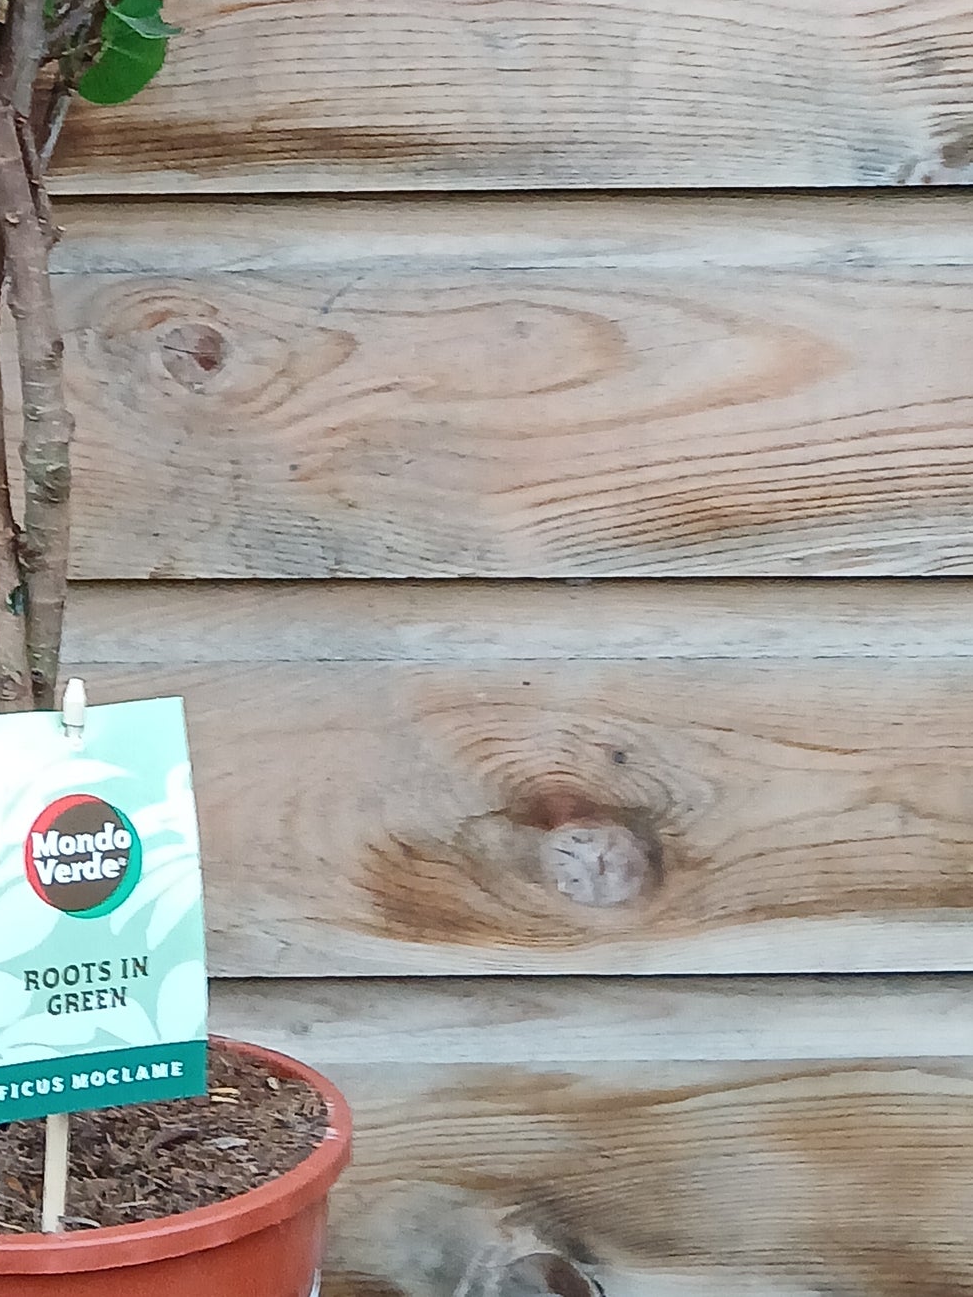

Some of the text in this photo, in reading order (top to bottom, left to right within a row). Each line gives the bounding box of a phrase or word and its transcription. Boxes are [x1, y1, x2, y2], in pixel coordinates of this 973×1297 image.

[31, 821, 132, 859] Mondo
[24, 956, 149, 991] ROOTS IN
[47, 986, 128, 1016] GREEN
[71, 1061, 184, 1090] MOCLAME
